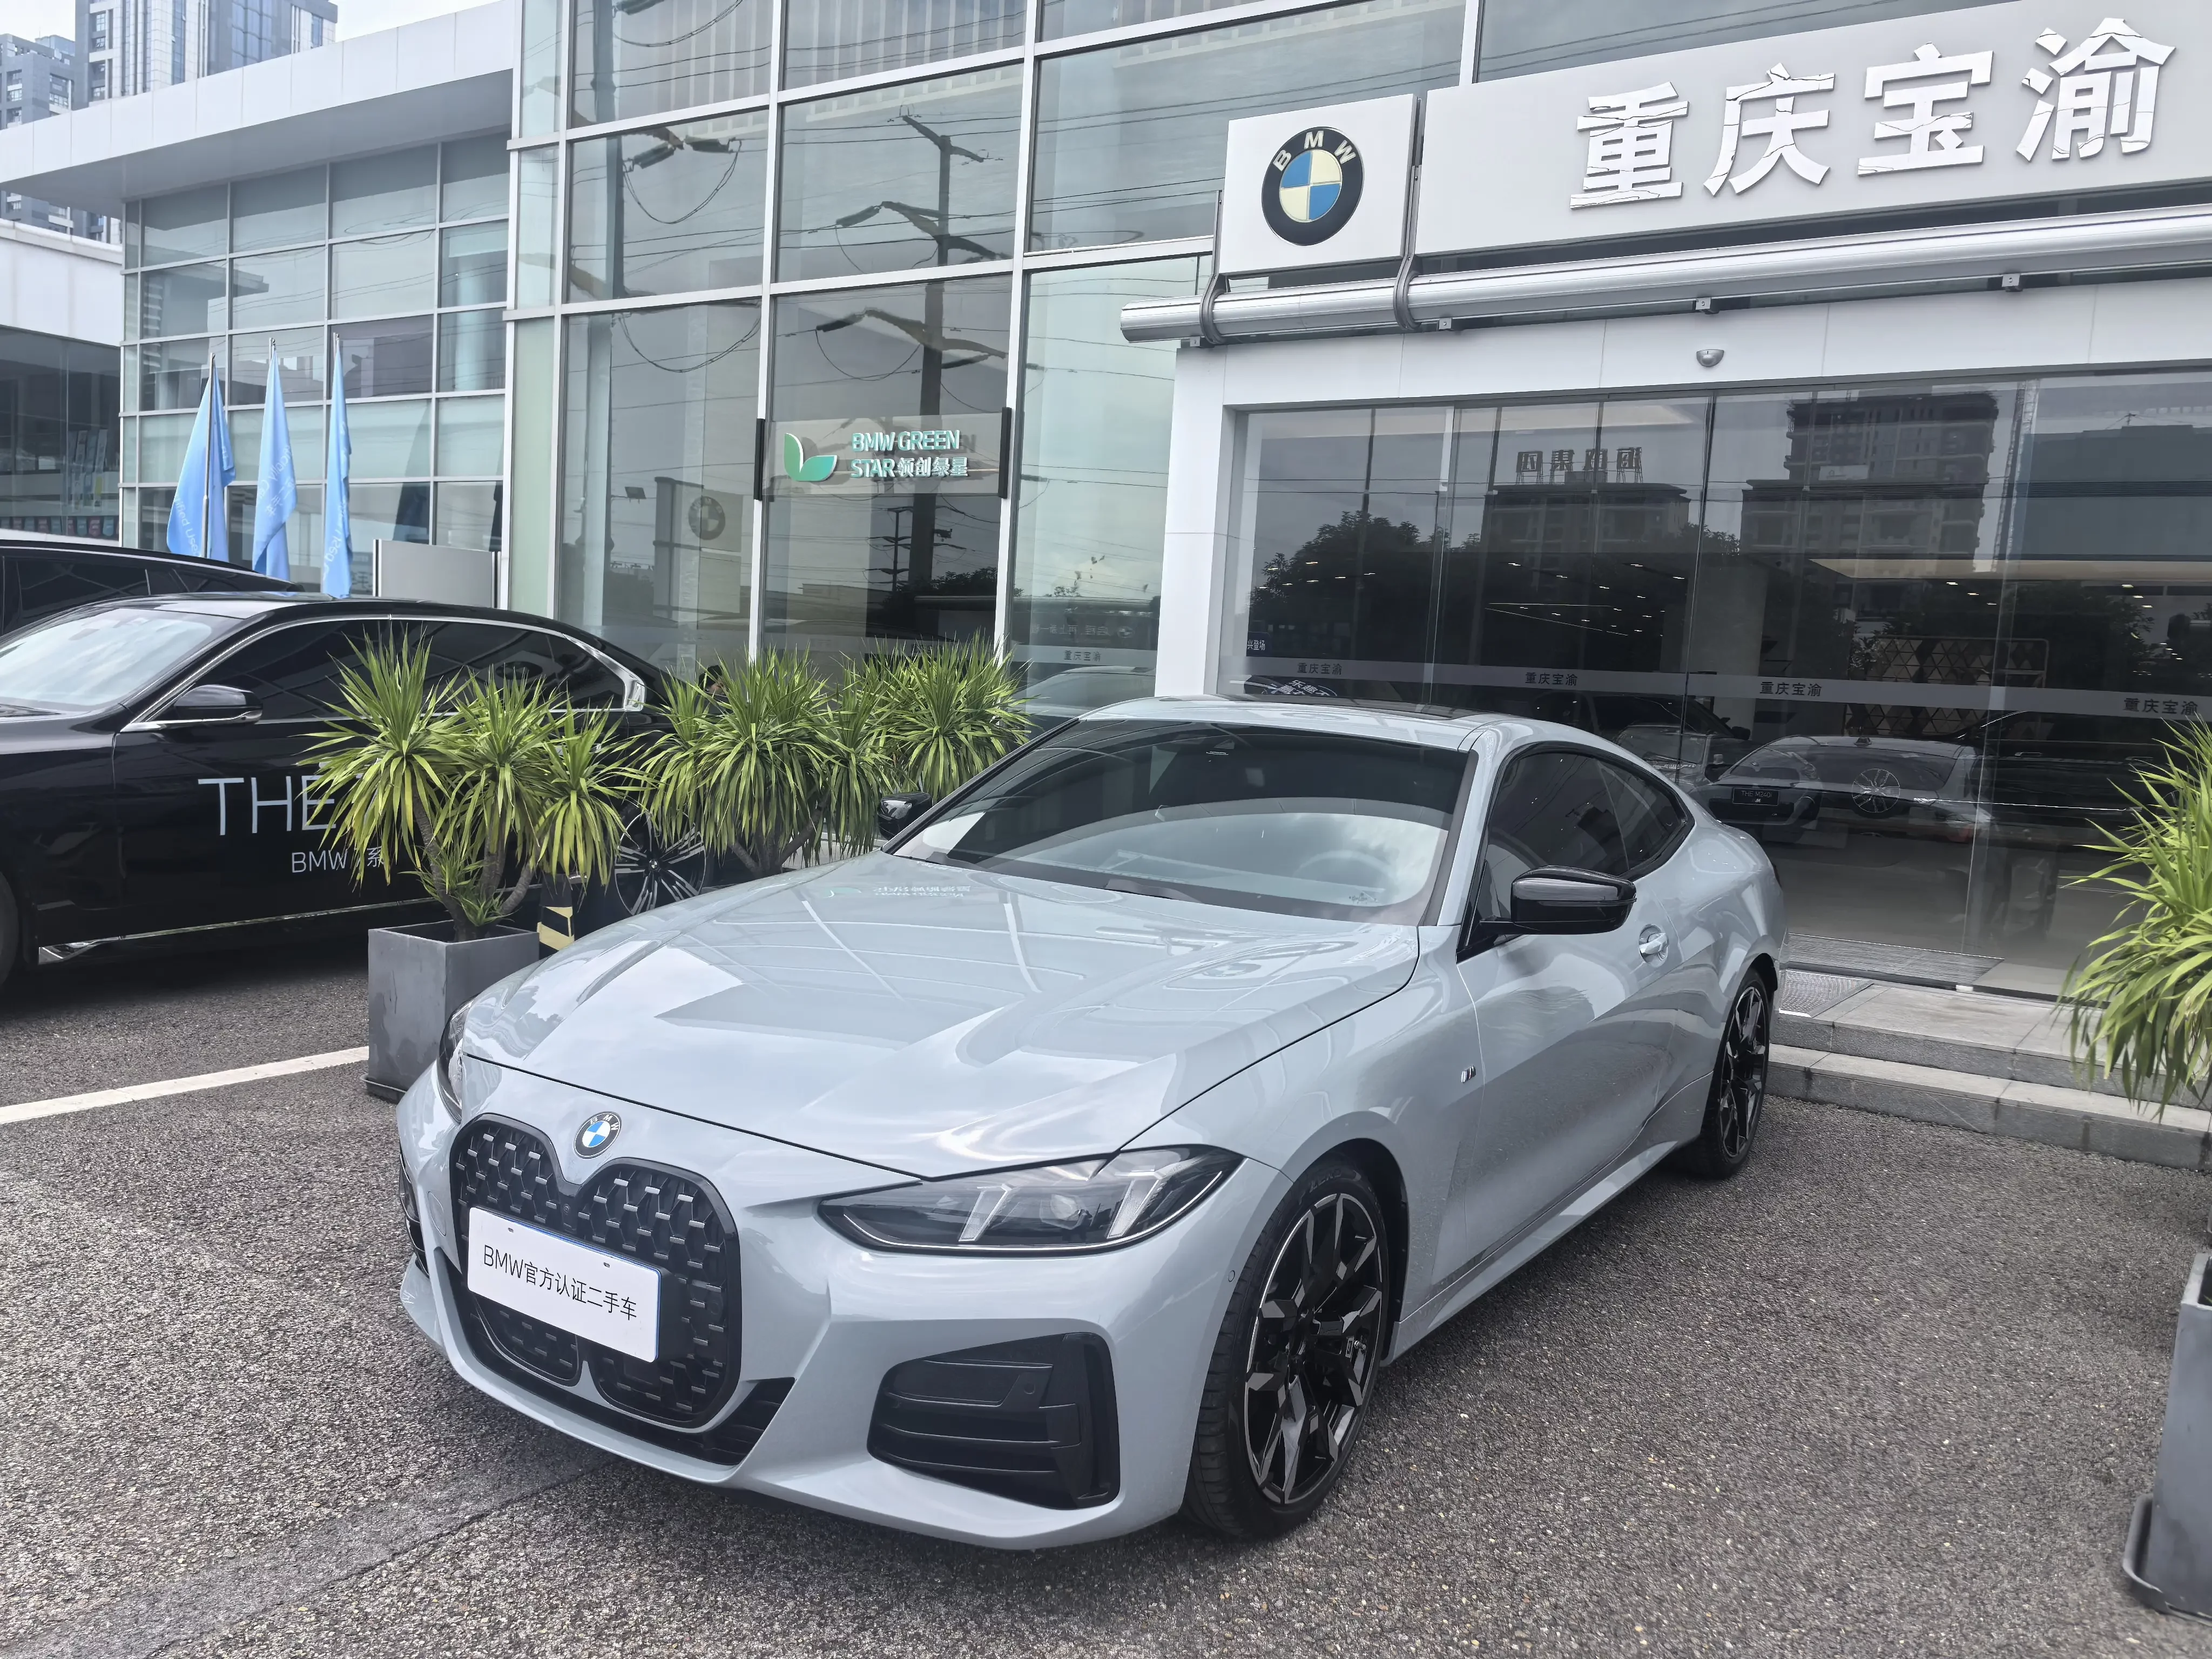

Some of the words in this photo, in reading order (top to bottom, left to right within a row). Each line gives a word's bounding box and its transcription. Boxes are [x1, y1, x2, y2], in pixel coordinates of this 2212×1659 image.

[1570, 18, 2176, 210] 重庆宝渝
[1272, 130, 1357, 172] BMW
[852, 431, 895, 452] BMW
[898, 430, 960, 451] GREEN
[850, 458, 895, 478] STAR
[897, 457, 968, 478] 领创绿星
[1297, 662, 1343, 675] 重庆宝渝
[1525, 672, 1578, 686] 重庆宝渝
[1759, 681, 1822, 697] 重庆宝渝
[2122, 698, 2198, 715] 重庆宝渝
[198, 775, 336, 835] THE
[292, 849, 348, 873] BMW
[590, 1114, 619, 1131] BMW
[483, 1244, 637, 1321] BMW官方认证二手车
